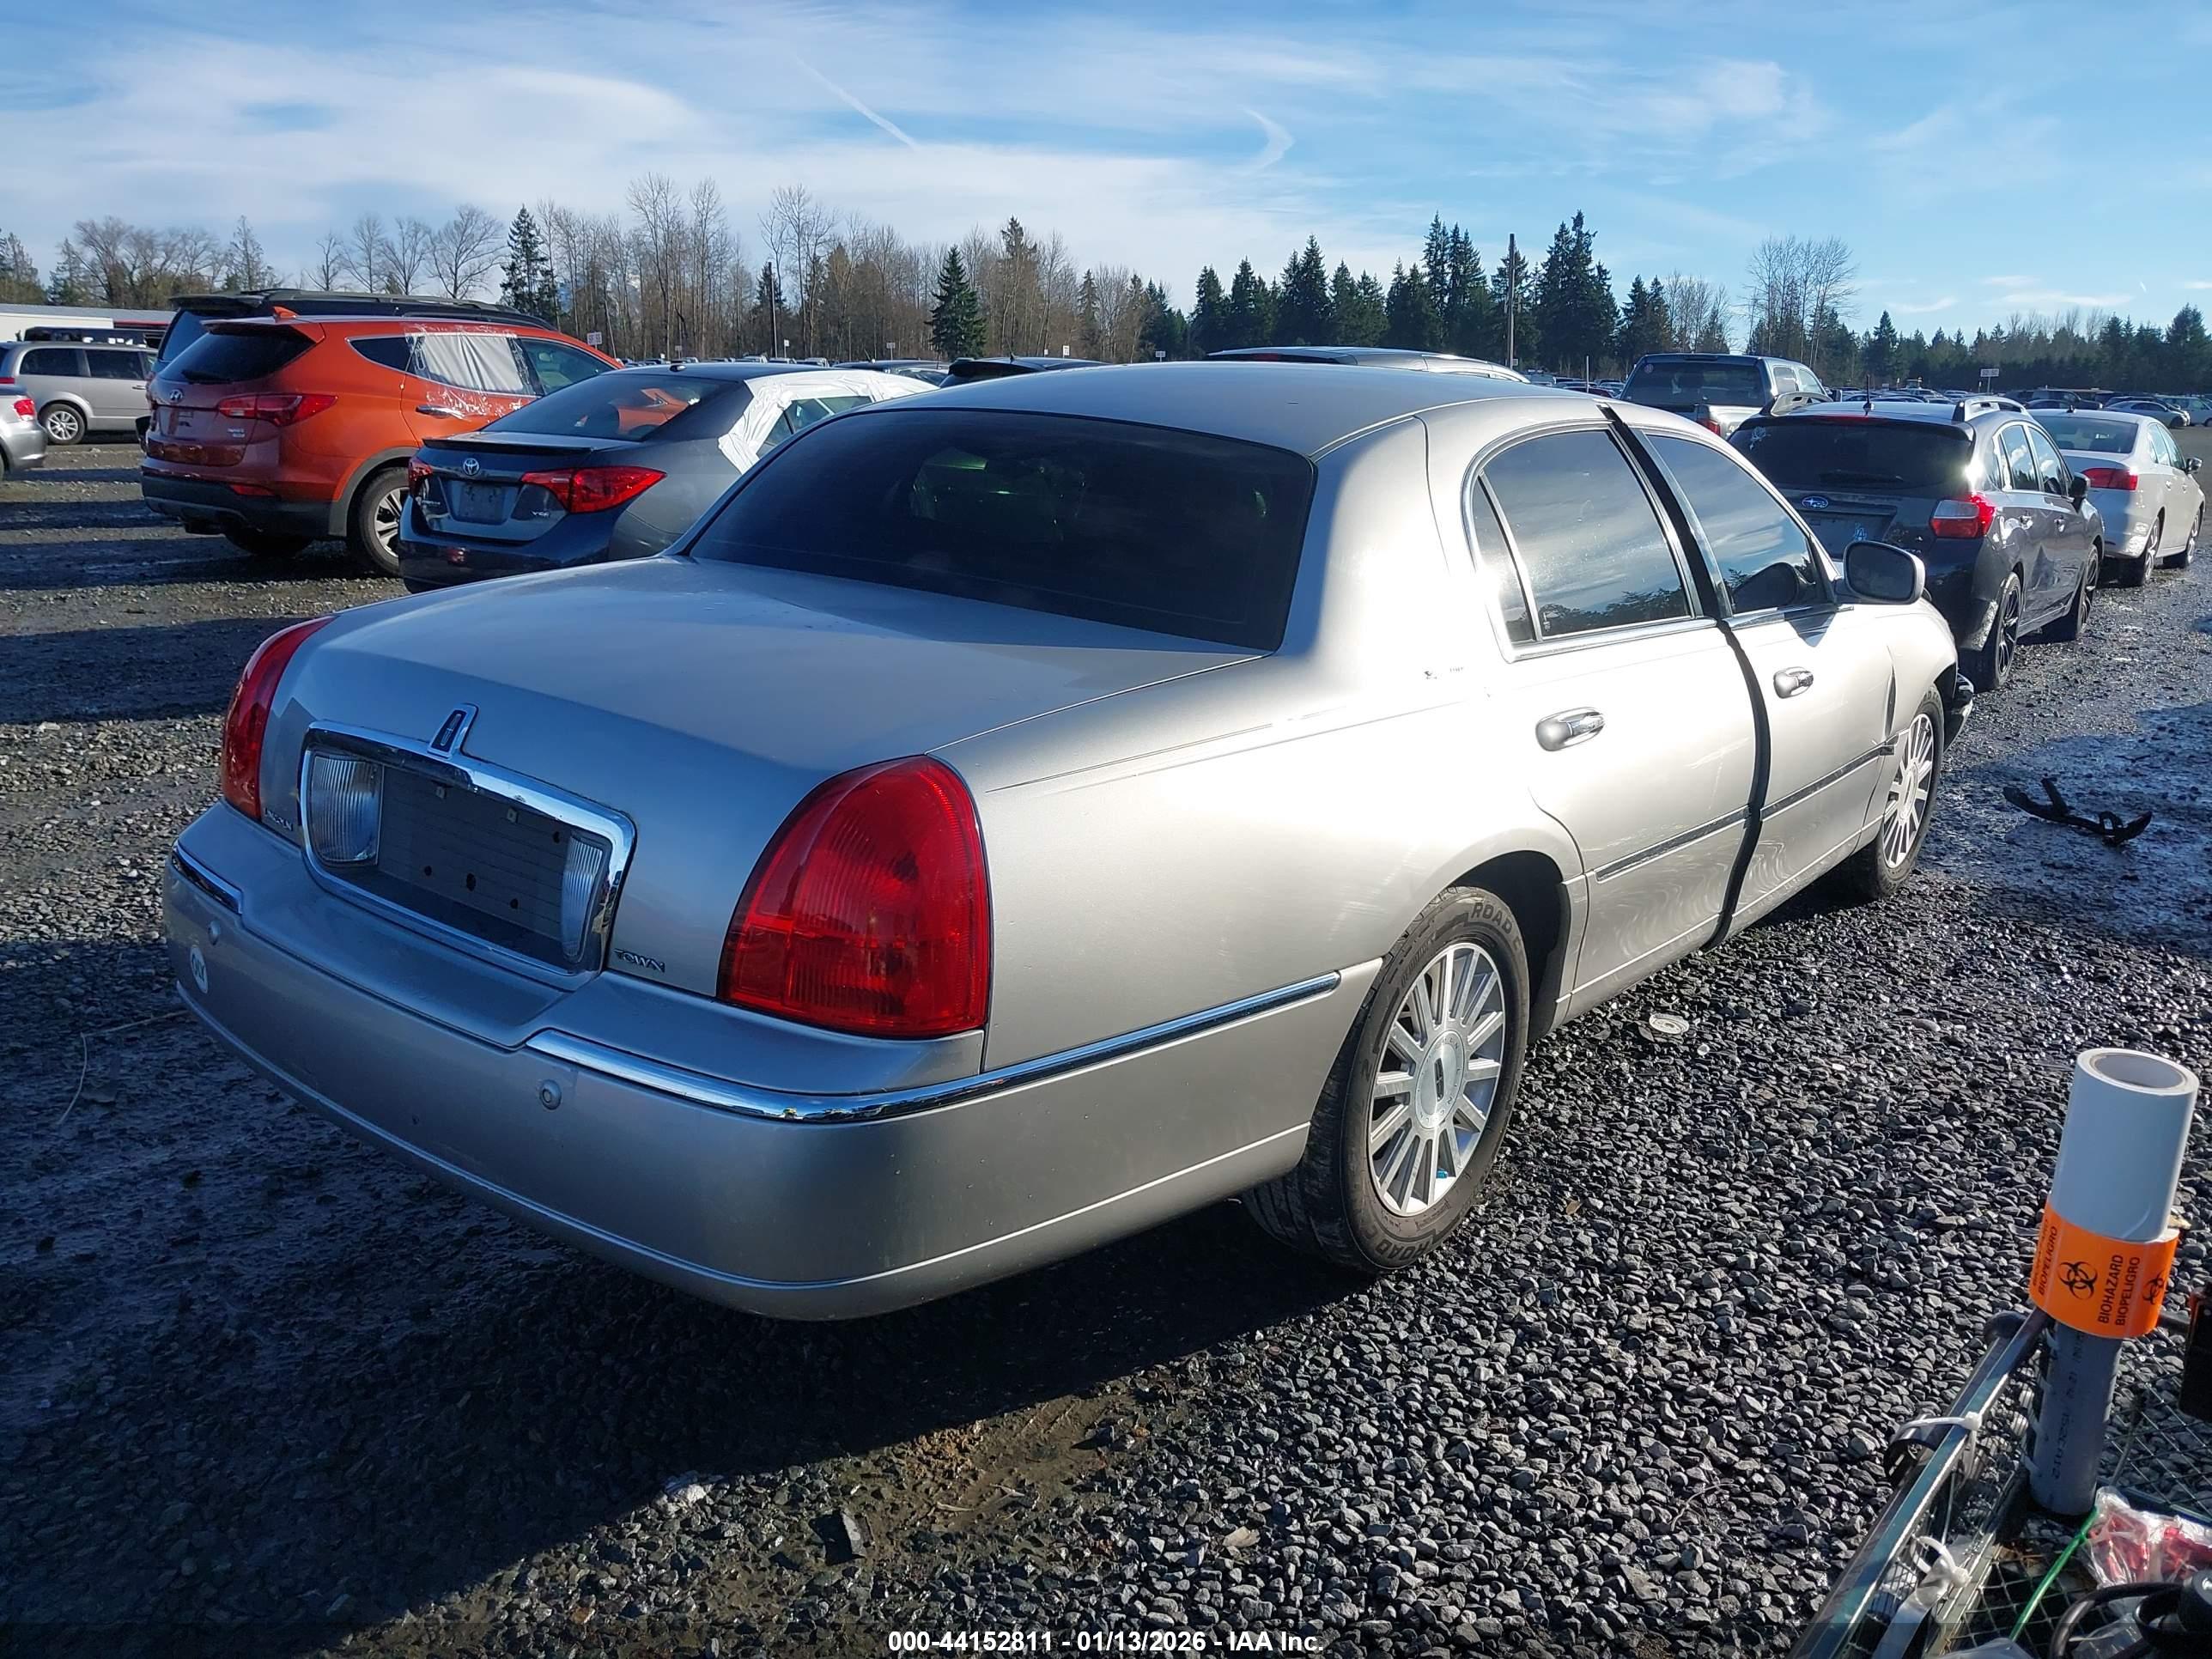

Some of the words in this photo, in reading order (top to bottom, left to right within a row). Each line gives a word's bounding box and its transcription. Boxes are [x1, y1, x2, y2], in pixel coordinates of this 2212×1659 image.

[1470, 902, 1513, 934] ROAD
[613, 947, 665, 974] TOWN
[2097, 1254, 2124, 1324] BIOHAZARD
[2115, 1256, 2142, 1327] BIOPELIGRO
